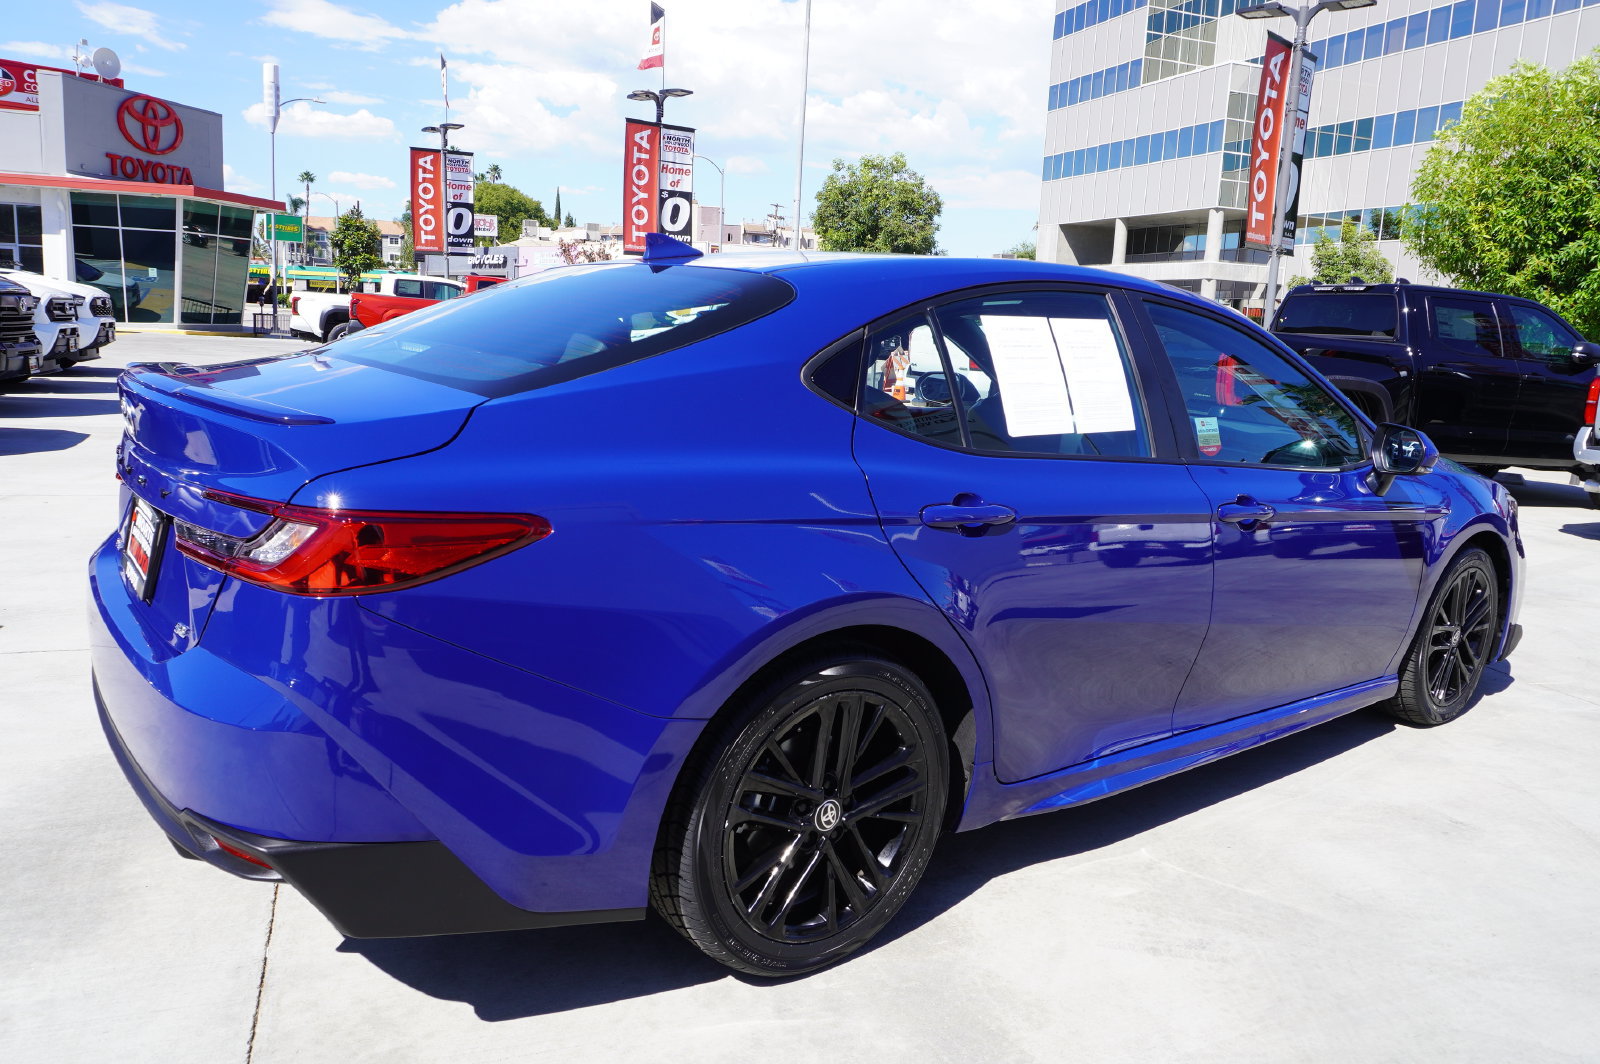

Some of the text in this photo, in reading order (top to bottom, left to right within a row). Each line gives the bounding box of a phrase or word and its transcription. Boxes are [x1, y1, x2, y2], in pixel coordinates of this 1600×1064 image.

[666, 135, 690, 143] NORTH
[1251, 51, 1286, 228] TOYOTA
[664, 144, 689, 153] TOYOTA
[105, 152, 195, 186] TOYOTA
[661, 164, 691, 176] Home
[447, 181, 472, 191] Home
[631, 129, 652, 242] TOYOTA
[669, 180, 680, 188] of
[418, 154, 436, 244] TOYOTA
[453, 192, 463, 200] of
[661, 191, 669, 199] $
[661, 197, 690, 232] 0
[447, 207, 473, 235] 0
[447, 235, 474, 243] down
[467, 254, 505, 265] BICYCLES
